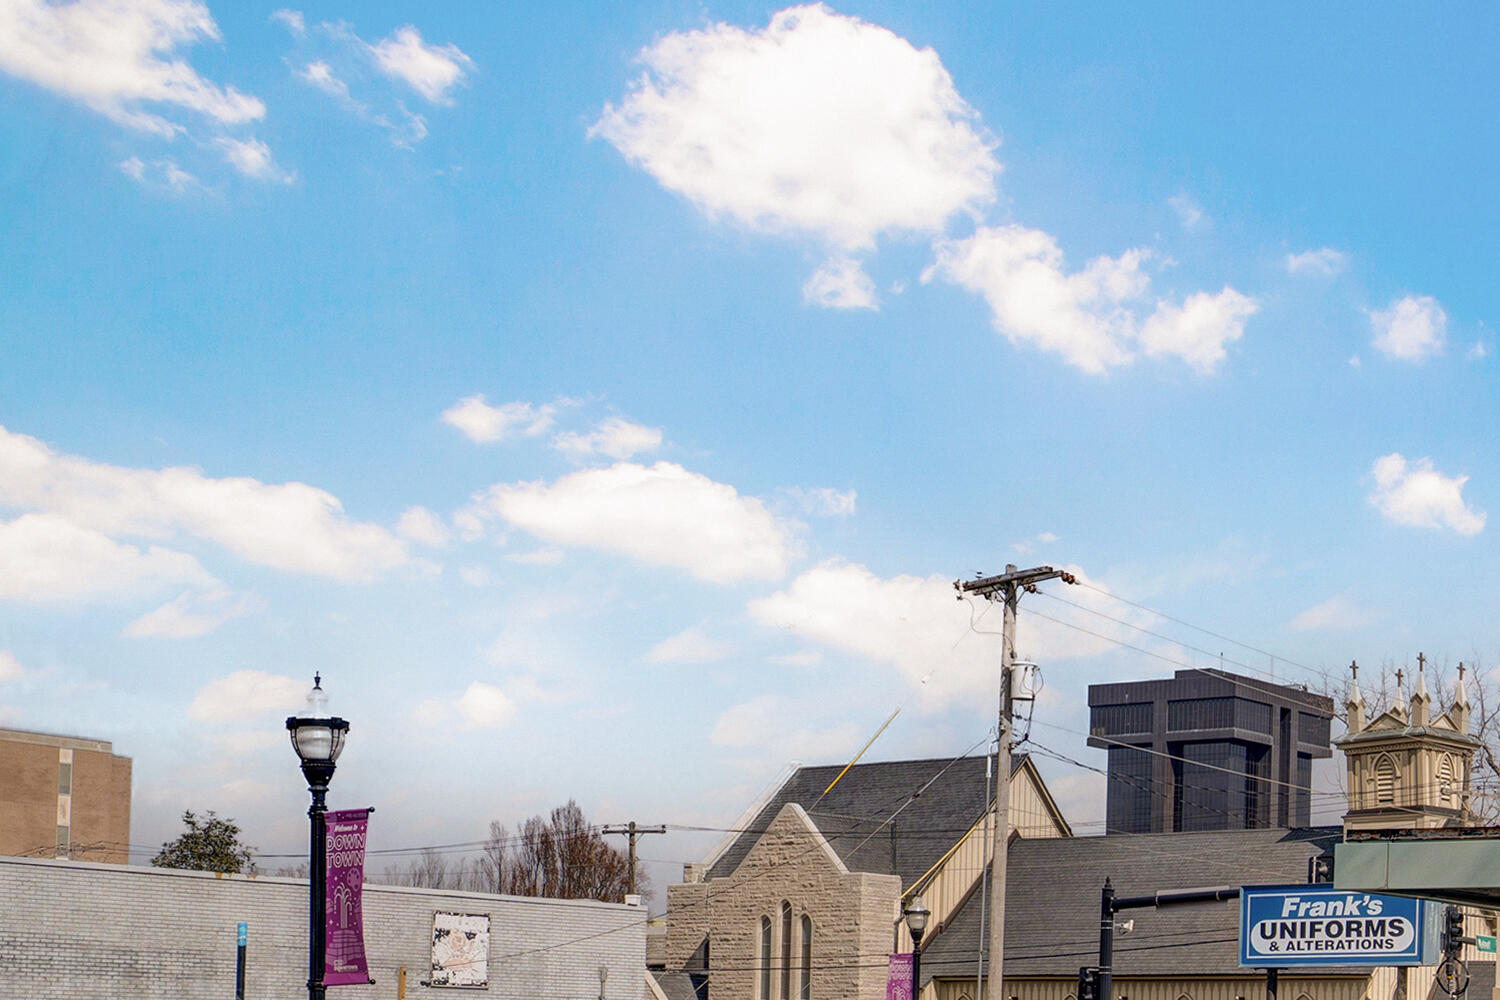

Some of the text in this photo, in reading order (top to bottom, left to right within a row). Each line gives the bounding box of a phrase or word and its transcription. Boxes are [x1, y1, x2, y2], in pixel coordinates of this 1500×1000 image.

[326, 832, 366, 852] DOWN
[326, 849, 364, 869] TOWN
[1281, 895, 1383, 918] Frank's
[1260, 918, 1405, 940] UNIFORMS
[1269, 938, 1395, 952] & ALTERATIONS
